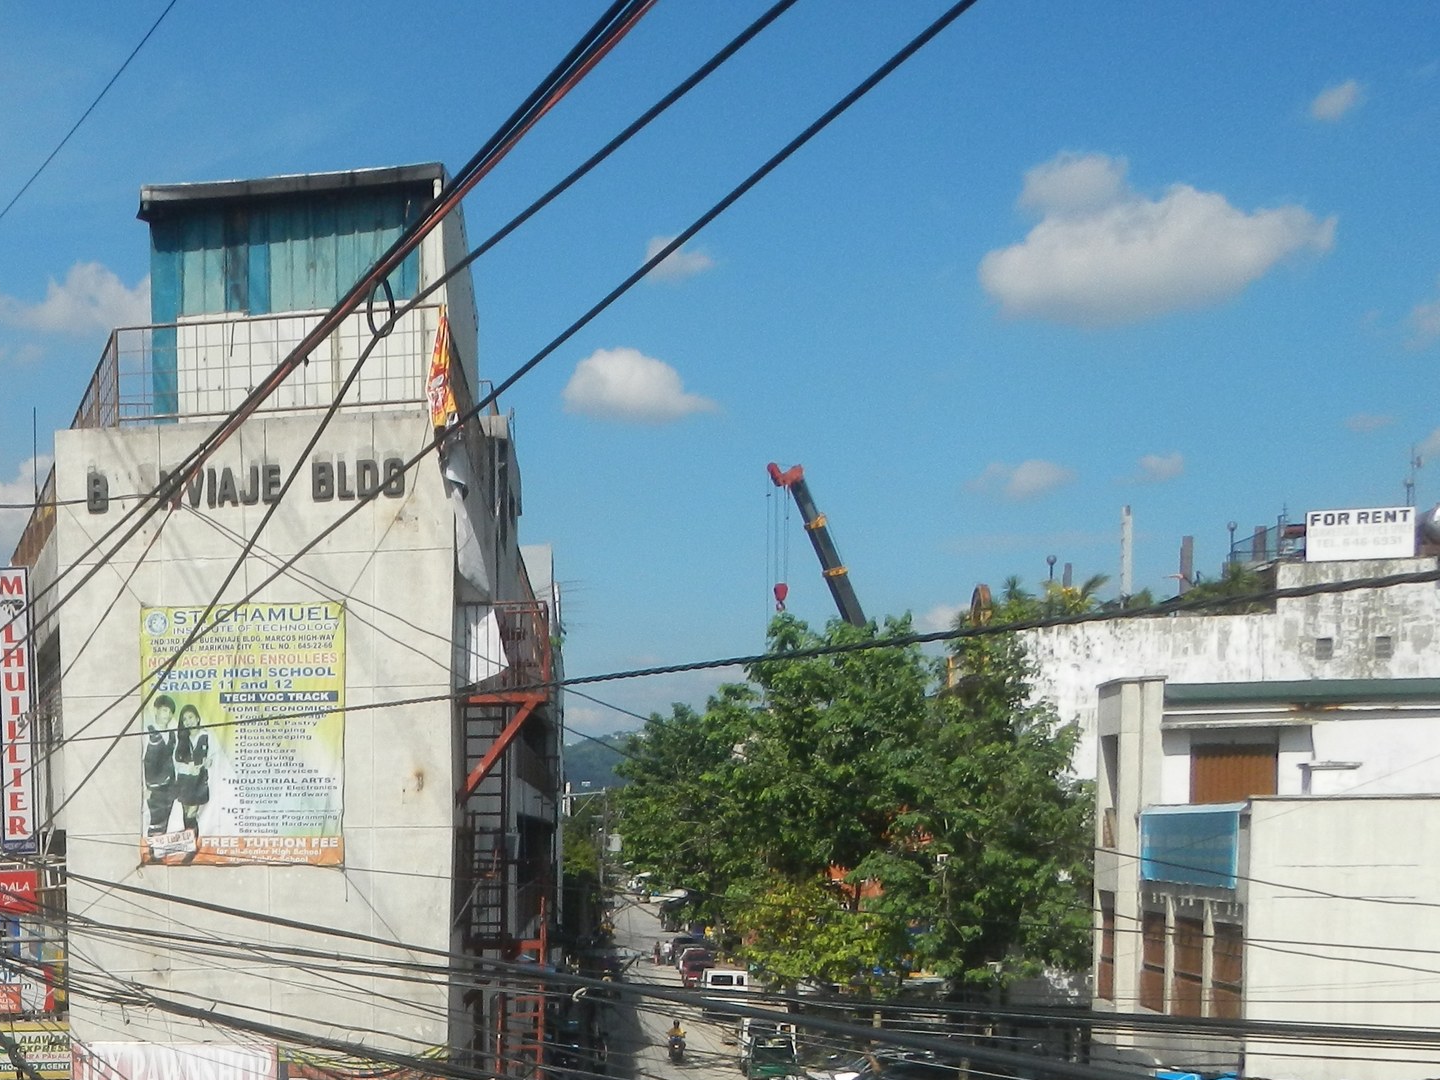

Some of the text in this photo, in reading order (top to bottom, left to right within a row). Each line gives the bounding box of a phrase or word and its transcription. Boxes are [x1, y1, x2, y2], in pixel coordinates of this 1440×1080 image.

[1310, 510, 1411, 526] FOR RENT
[215, 606, 338, 623] CHAMUEL
[256, 622, 340, 633] TECHNOLOGY
[199, 643, 237, 651] MARIKINA
[182, 653, 256, 667] ACCEPTING
[260, 652, 338, 665] ENROLLEES
[223, 668, 262, 678] HIGH
[268, 667, 336, 677] SCHOOL
[219, 681, 234, 690] 11
[240, 679, 268, 690] and
[274, 679, 293, 689] 12
[224, 692, 329, 702] TECH VOC TRACK
[201, 837, 239, 848] FREE
[243, 837, 307, 848] TUITION
[311, 837, 339, 848] FEE
[272, 848, 291, 856] High
[293, 848, 322, 856] School
[40, 1062, 70, 1070] AGENT
